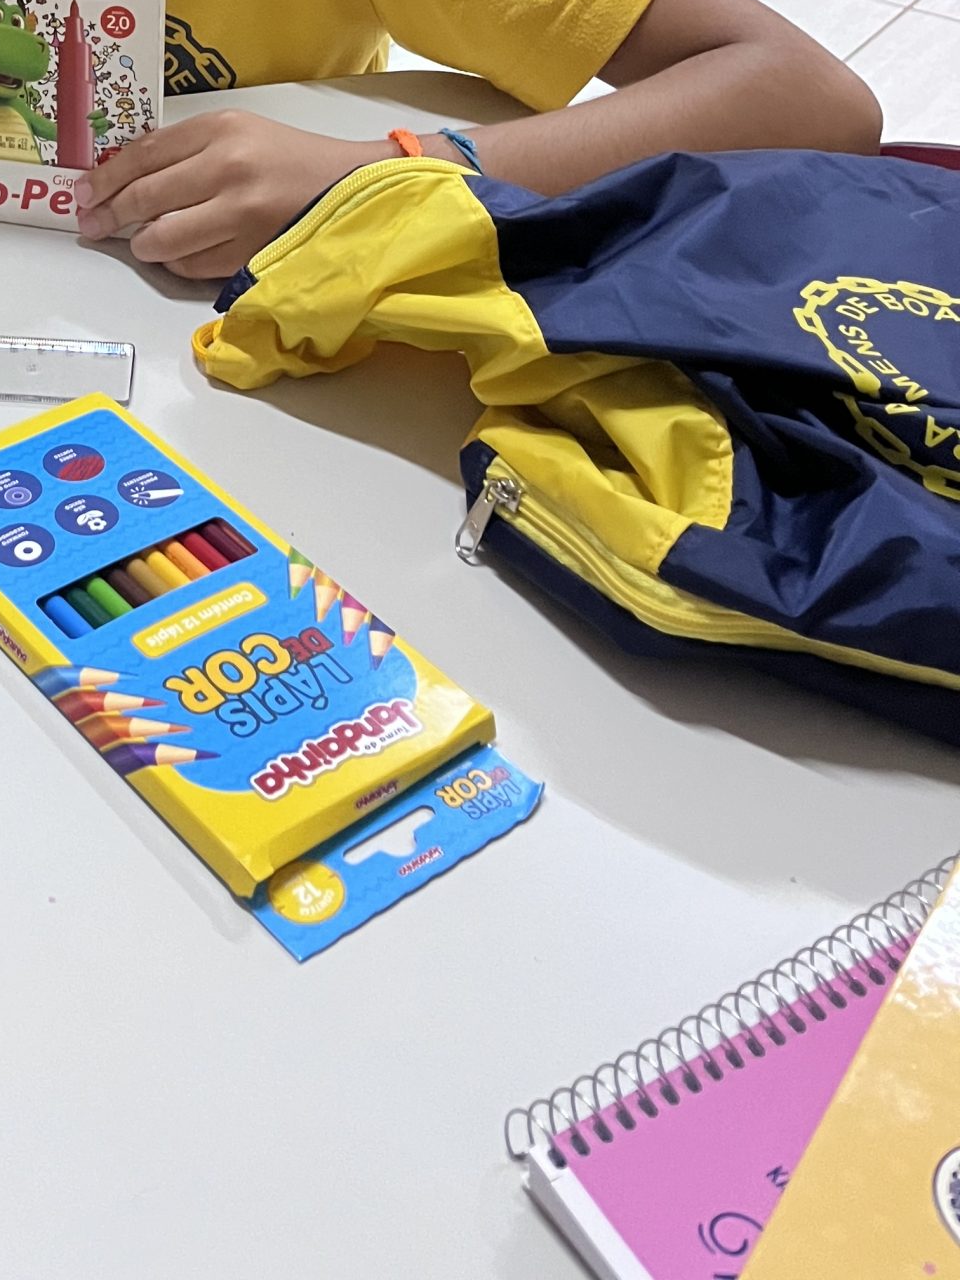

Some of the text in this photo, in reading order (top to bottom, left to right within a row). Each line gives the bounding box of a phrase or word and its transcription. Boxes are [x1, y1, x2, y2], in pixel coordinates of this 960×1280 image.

[107, 15, 130, 31] 2,0
[836, 296, 879, 322] DE
[1, 530, 29, 546] FORMATO
[145, 589, 254, 647] Contém 12 lápis
[163, 626, 334, 714] DE COR
[215, 652, 353, 738] LÁPIS
[254, 700, 418, 796] Jandainha
[379, 725, 410, 745] Turma
[436, 769, 493, 808] COR
[461, 778, 521, 819] LÁPIS
[292, 880, 321, 905] 12
